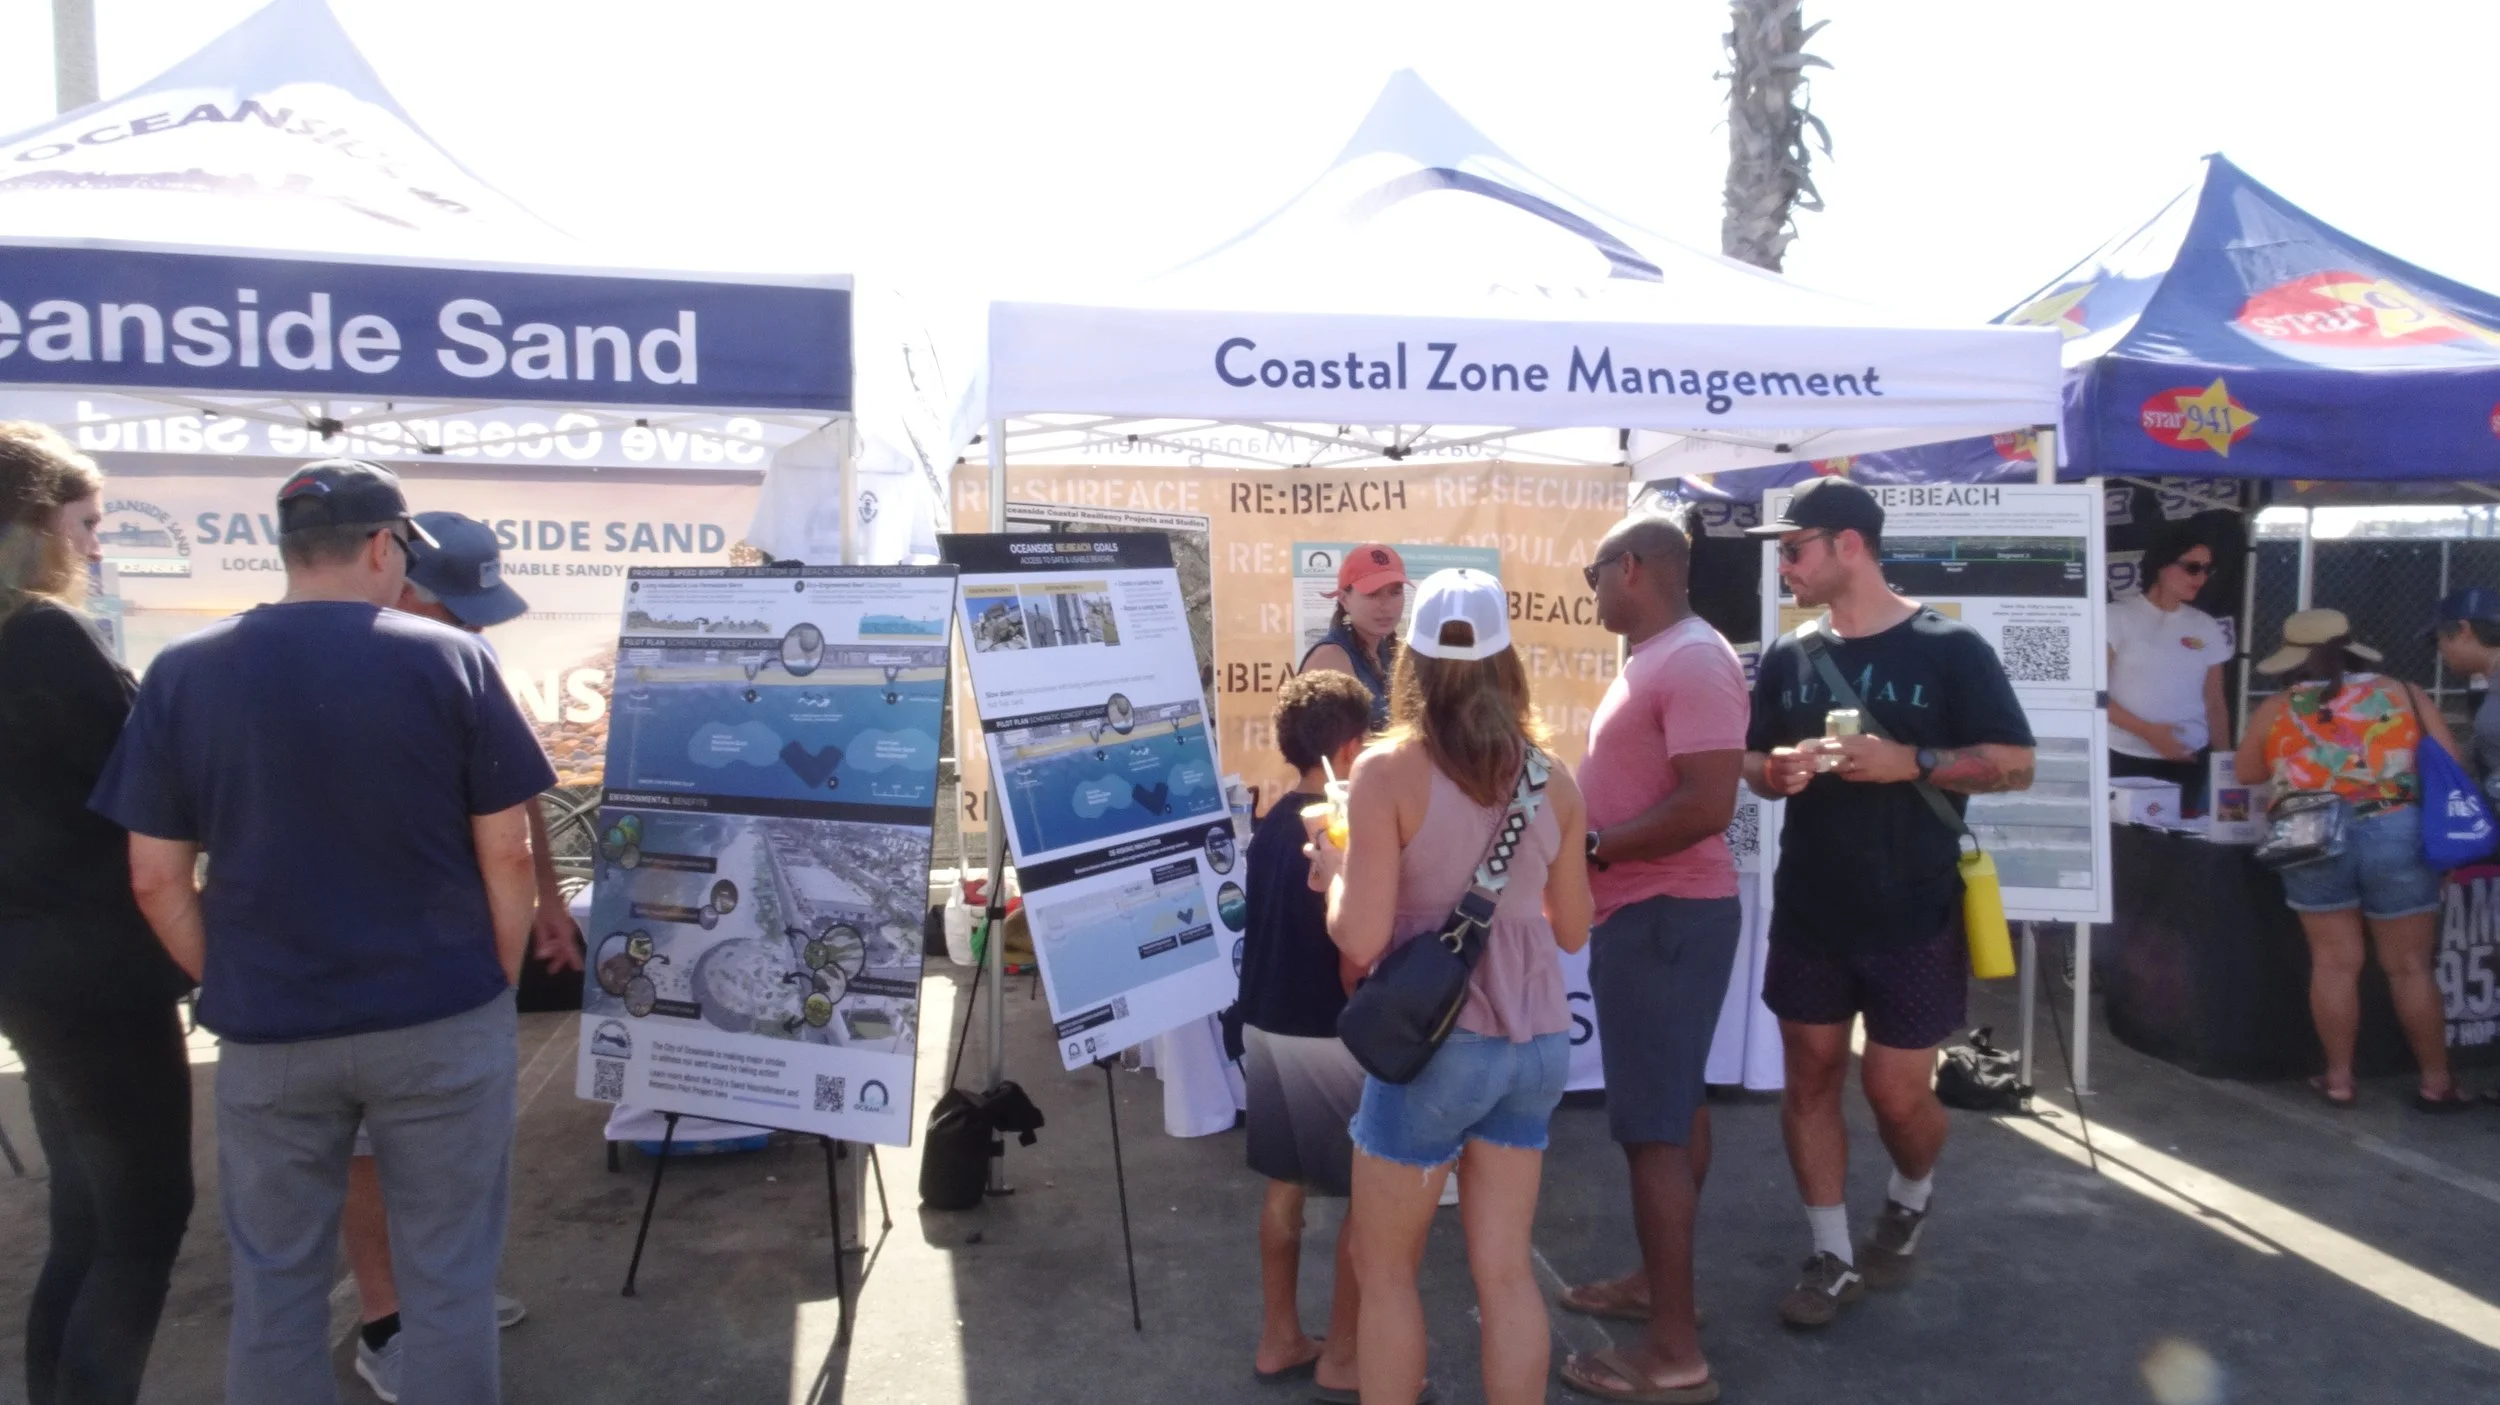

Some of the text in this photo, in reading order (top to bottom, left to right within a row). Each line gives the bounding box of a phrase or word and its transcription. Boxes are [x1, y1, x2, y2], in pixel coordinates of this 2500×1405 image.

[437, 298, 698, 385] Sand
[1215, 337, 1884, 415] Coastal Zone Management
[1230, 480, 1407, 515] RE:BEACH
[1434, 475, 1629, 513] RE:SECURE
[1047, 508, 1078, 518] Coastal
[604, 521, 726, 554] SAND
[1093, 542, 1118, 552] GOALS
[565, 564, 622, 578] SANDY
[623, 639, 644, 647] PILOT
[646, 639, 666, 647] PLAN
